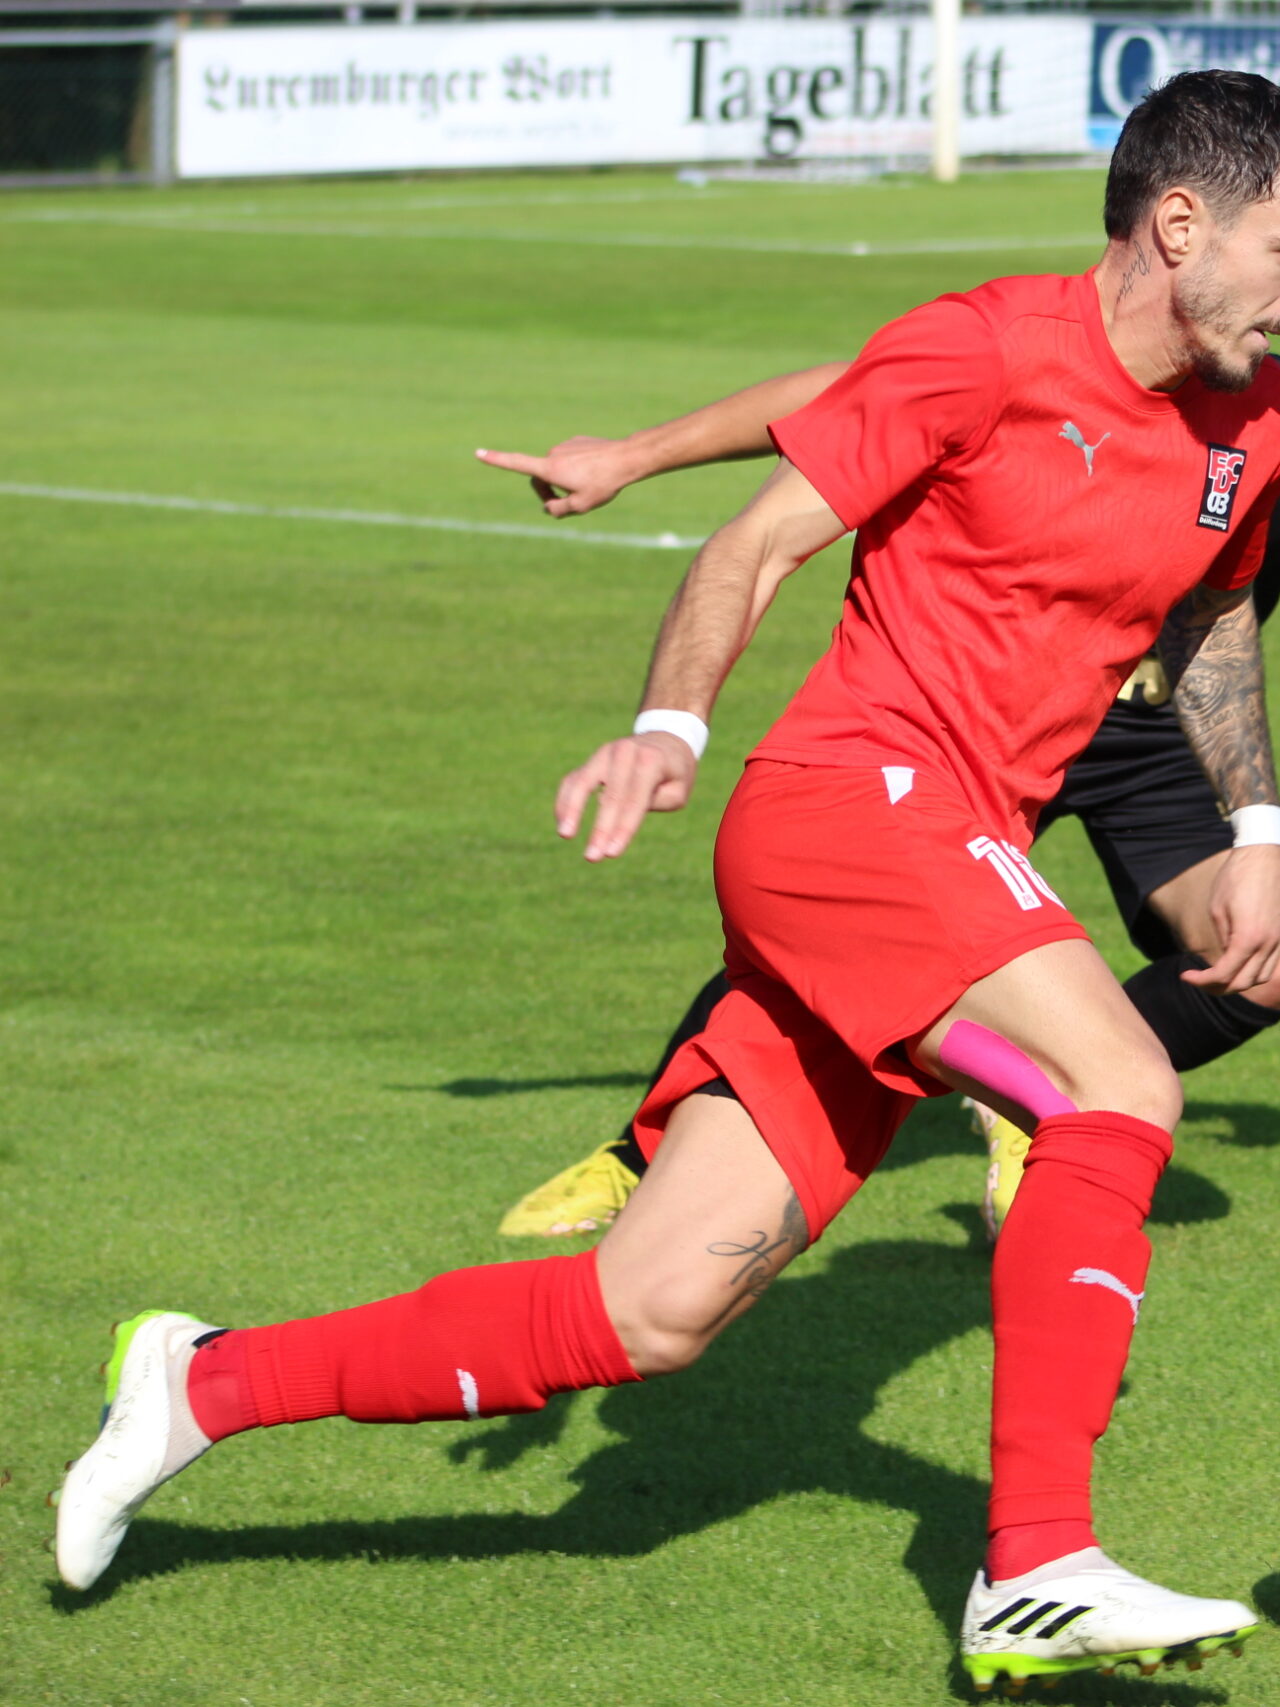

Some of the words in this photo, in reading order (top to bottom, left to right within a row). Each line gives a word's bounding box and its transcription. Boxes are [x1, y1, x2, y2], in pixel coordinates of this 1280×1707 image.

[502, 54, 611, 102] Wort
[672, 25, 1014, 158] Tageblatt
[1207, 491, 1230, 515] 03
